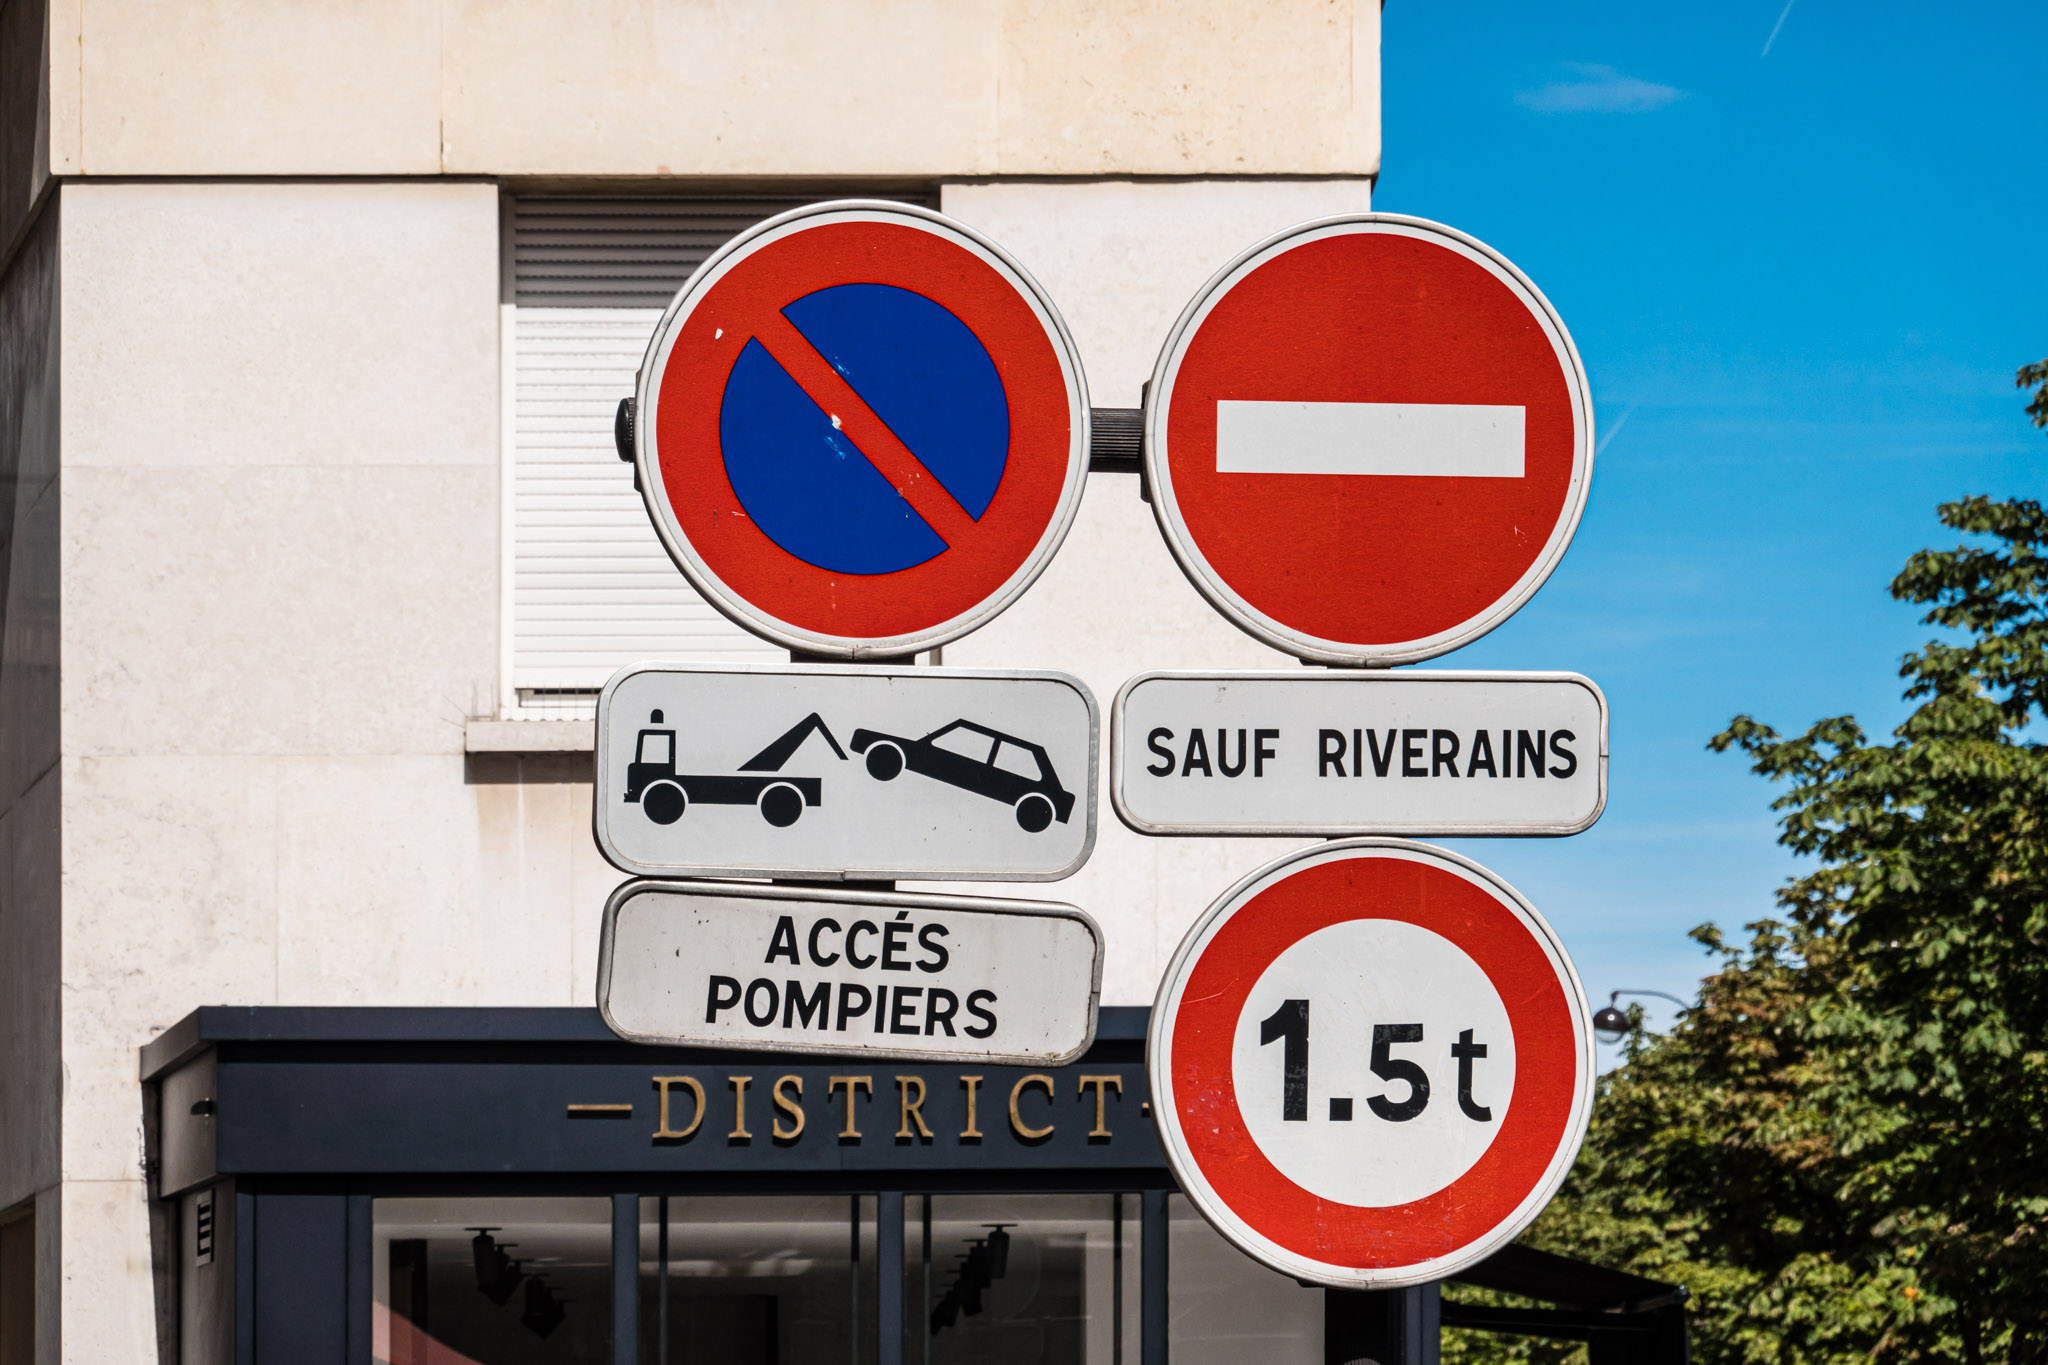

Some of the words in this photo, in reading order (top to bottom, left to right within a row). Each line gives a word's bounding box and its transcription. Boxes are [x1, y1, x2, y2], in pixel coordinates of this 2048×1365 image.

[1146, 727, 1280, 778] SAUF
[1318, 728, 1578, 780] RIVERAINS
[764, 910, 950, 974] ACCÉS
[705, 974, 998, 1040] POMPIERS
[652, 1074, 1123, 1139] DISTRICT
